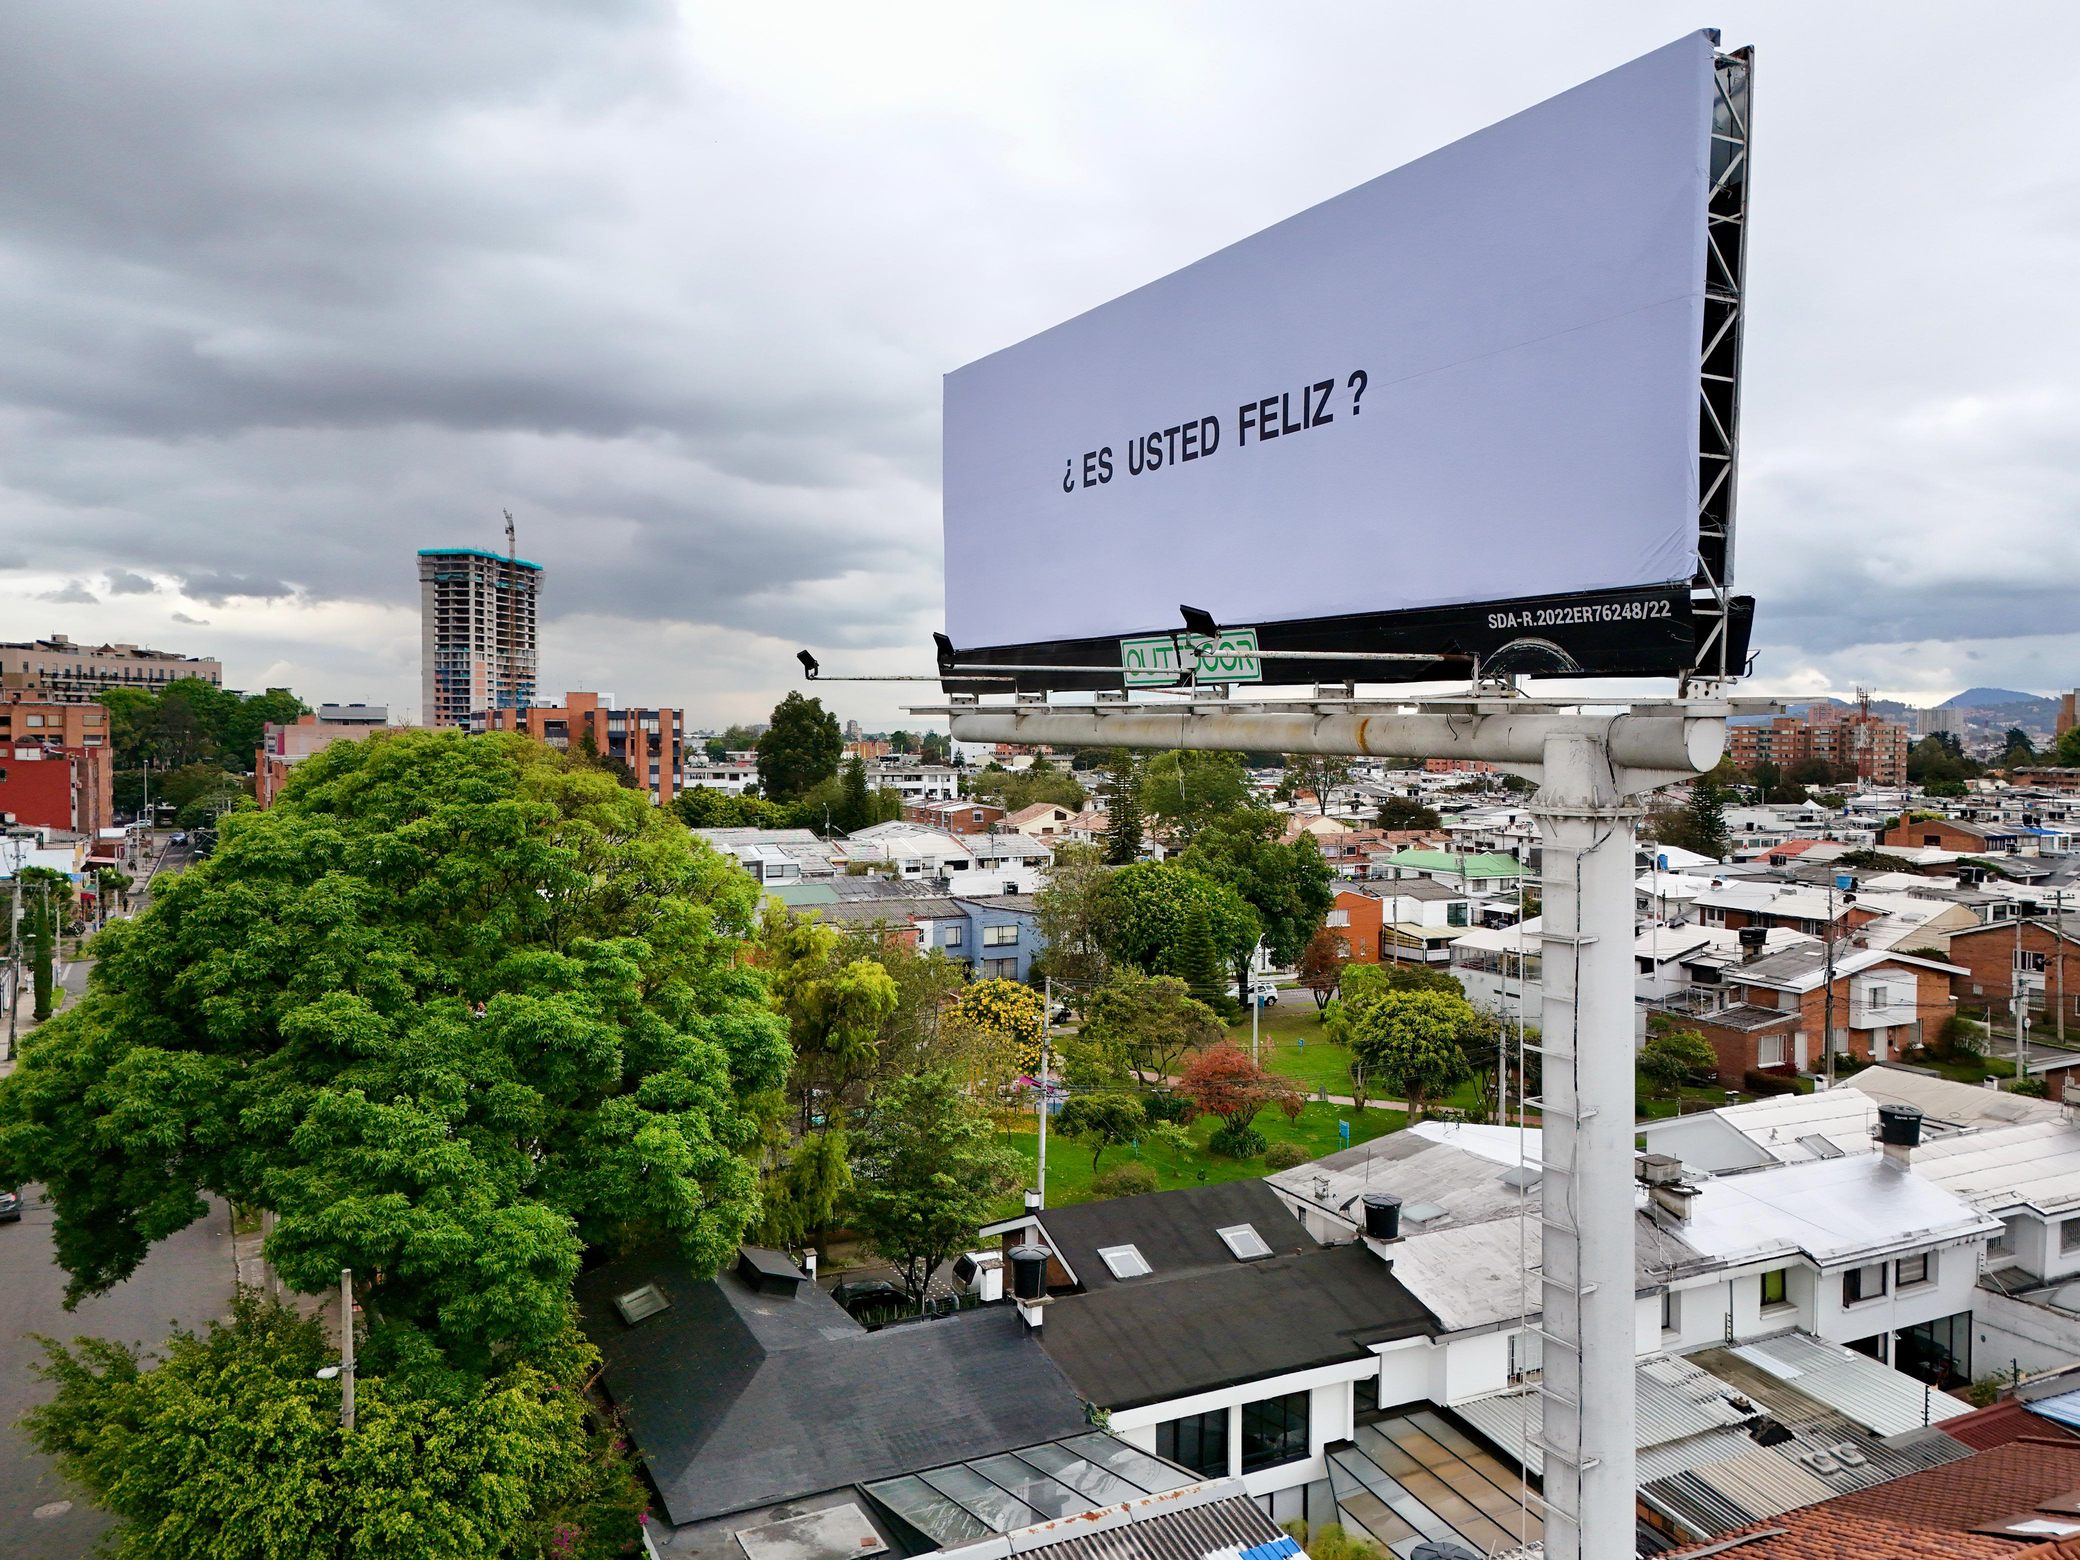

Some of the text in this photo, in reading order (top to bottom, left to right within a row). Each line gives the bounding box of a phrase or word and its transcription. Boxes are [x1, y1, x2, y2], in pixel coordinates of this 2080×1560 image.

[1083, 446, 1114, 489] ES
[1128, 415, 1220, 476] USTED
[1239, 378, 1335, 447] FELIZ
[1488, 600, 1672, 630] SDA-R.2022ER76248/22
